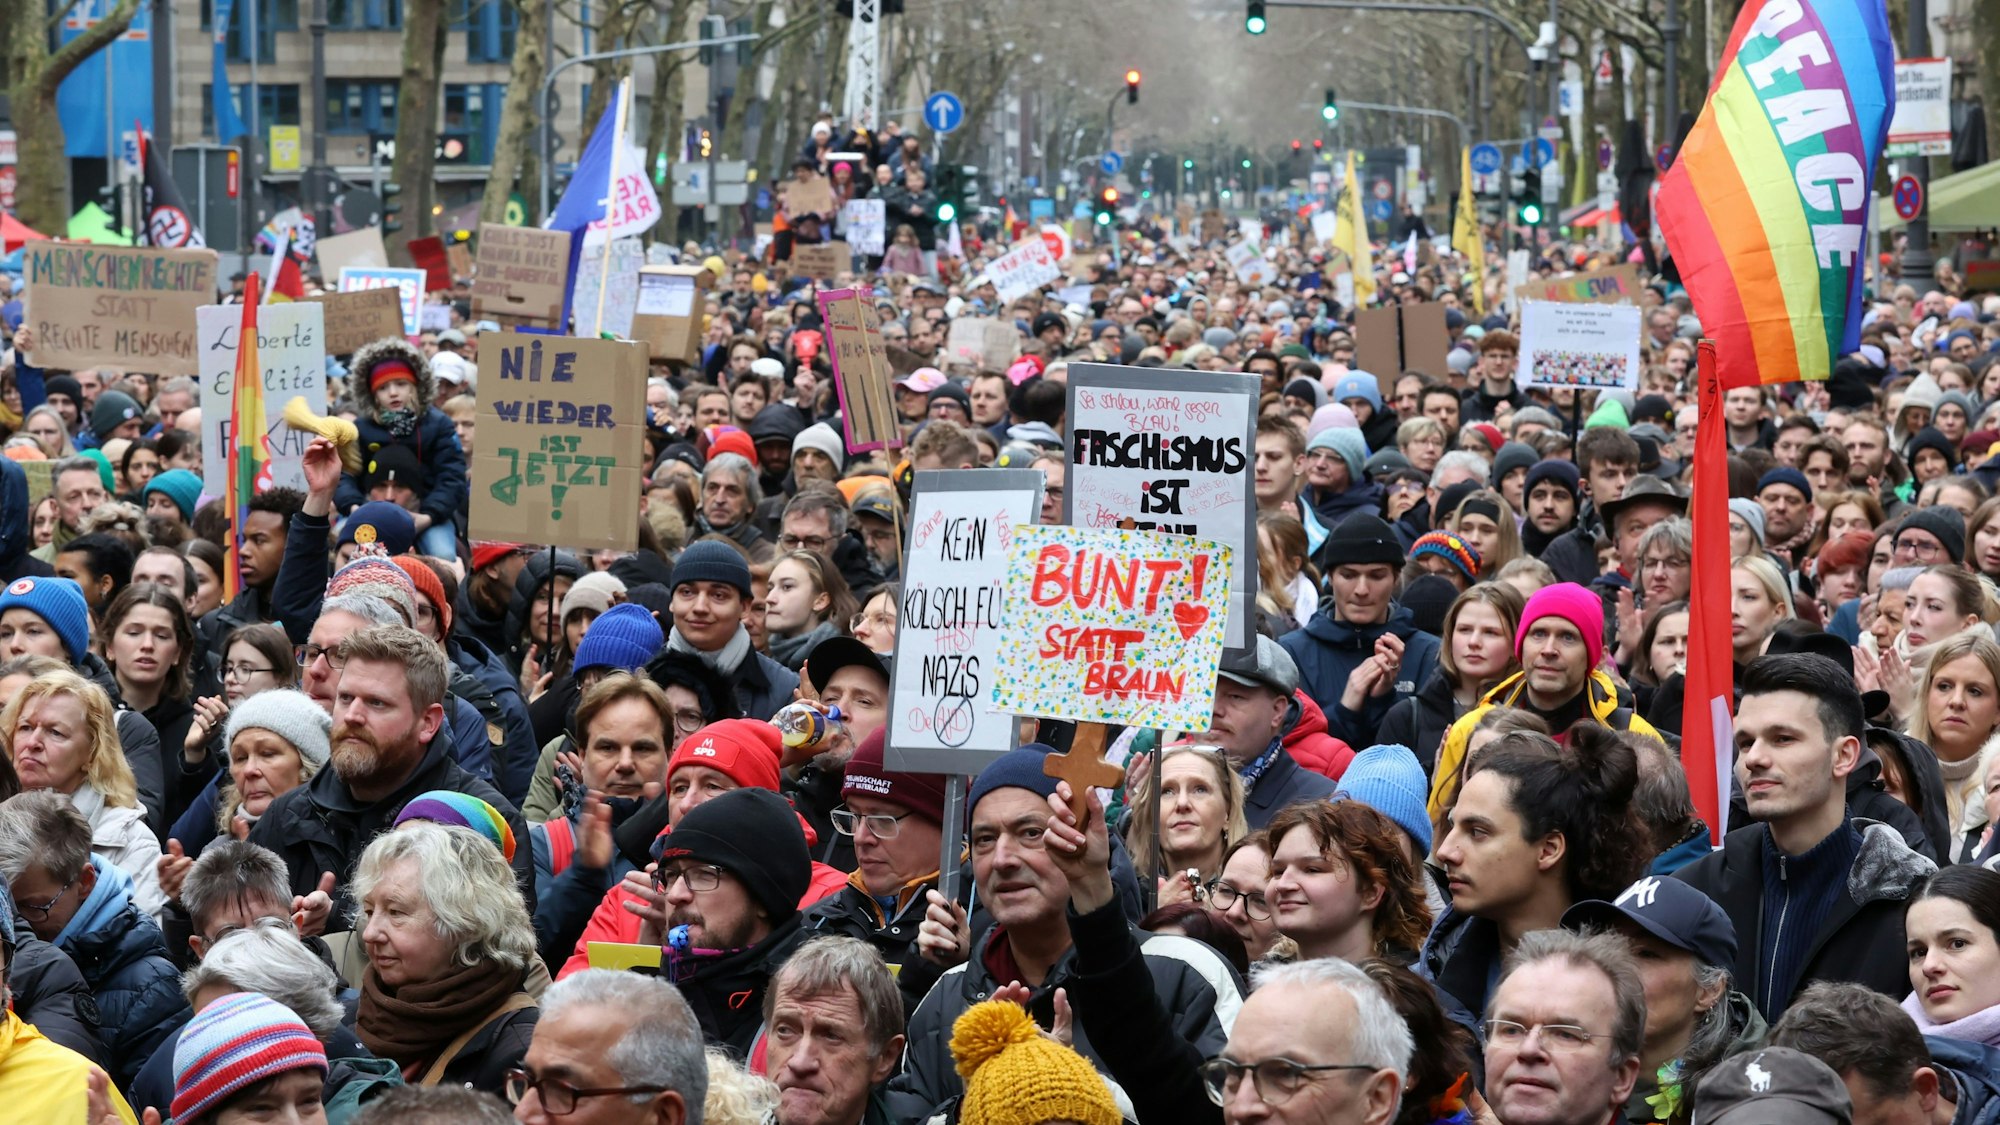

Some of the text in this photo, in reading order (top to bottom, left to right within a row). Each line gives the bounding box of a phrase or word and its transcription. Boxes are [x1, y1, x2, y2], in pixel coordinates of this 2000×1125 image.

[1738, 0, 1865, 270] PEACE
[32, 248, 208, 291] MENSCHENRECHTE
[92, 295, 157, 320] STATT
[39, 321, 193, 358] RECHTE MENSCHEN
[211, 323, 313, 350] Lberté
[213, 366, 315, 395] Elité
[1079, 390, 1096, 410] Sei
[1184, 401, 1221, 423] gegen
[1124, 413, 1180, 432] BLAU!
[490, 447, 616, 506] JETZT
[902, 580, 1002, 630] KÖLSCH FÜ
[1039, 624, 1145, 662] STATT
[1083, 662, 1186, 702] BRAUN
[693, 747, 716, 757] SPD
